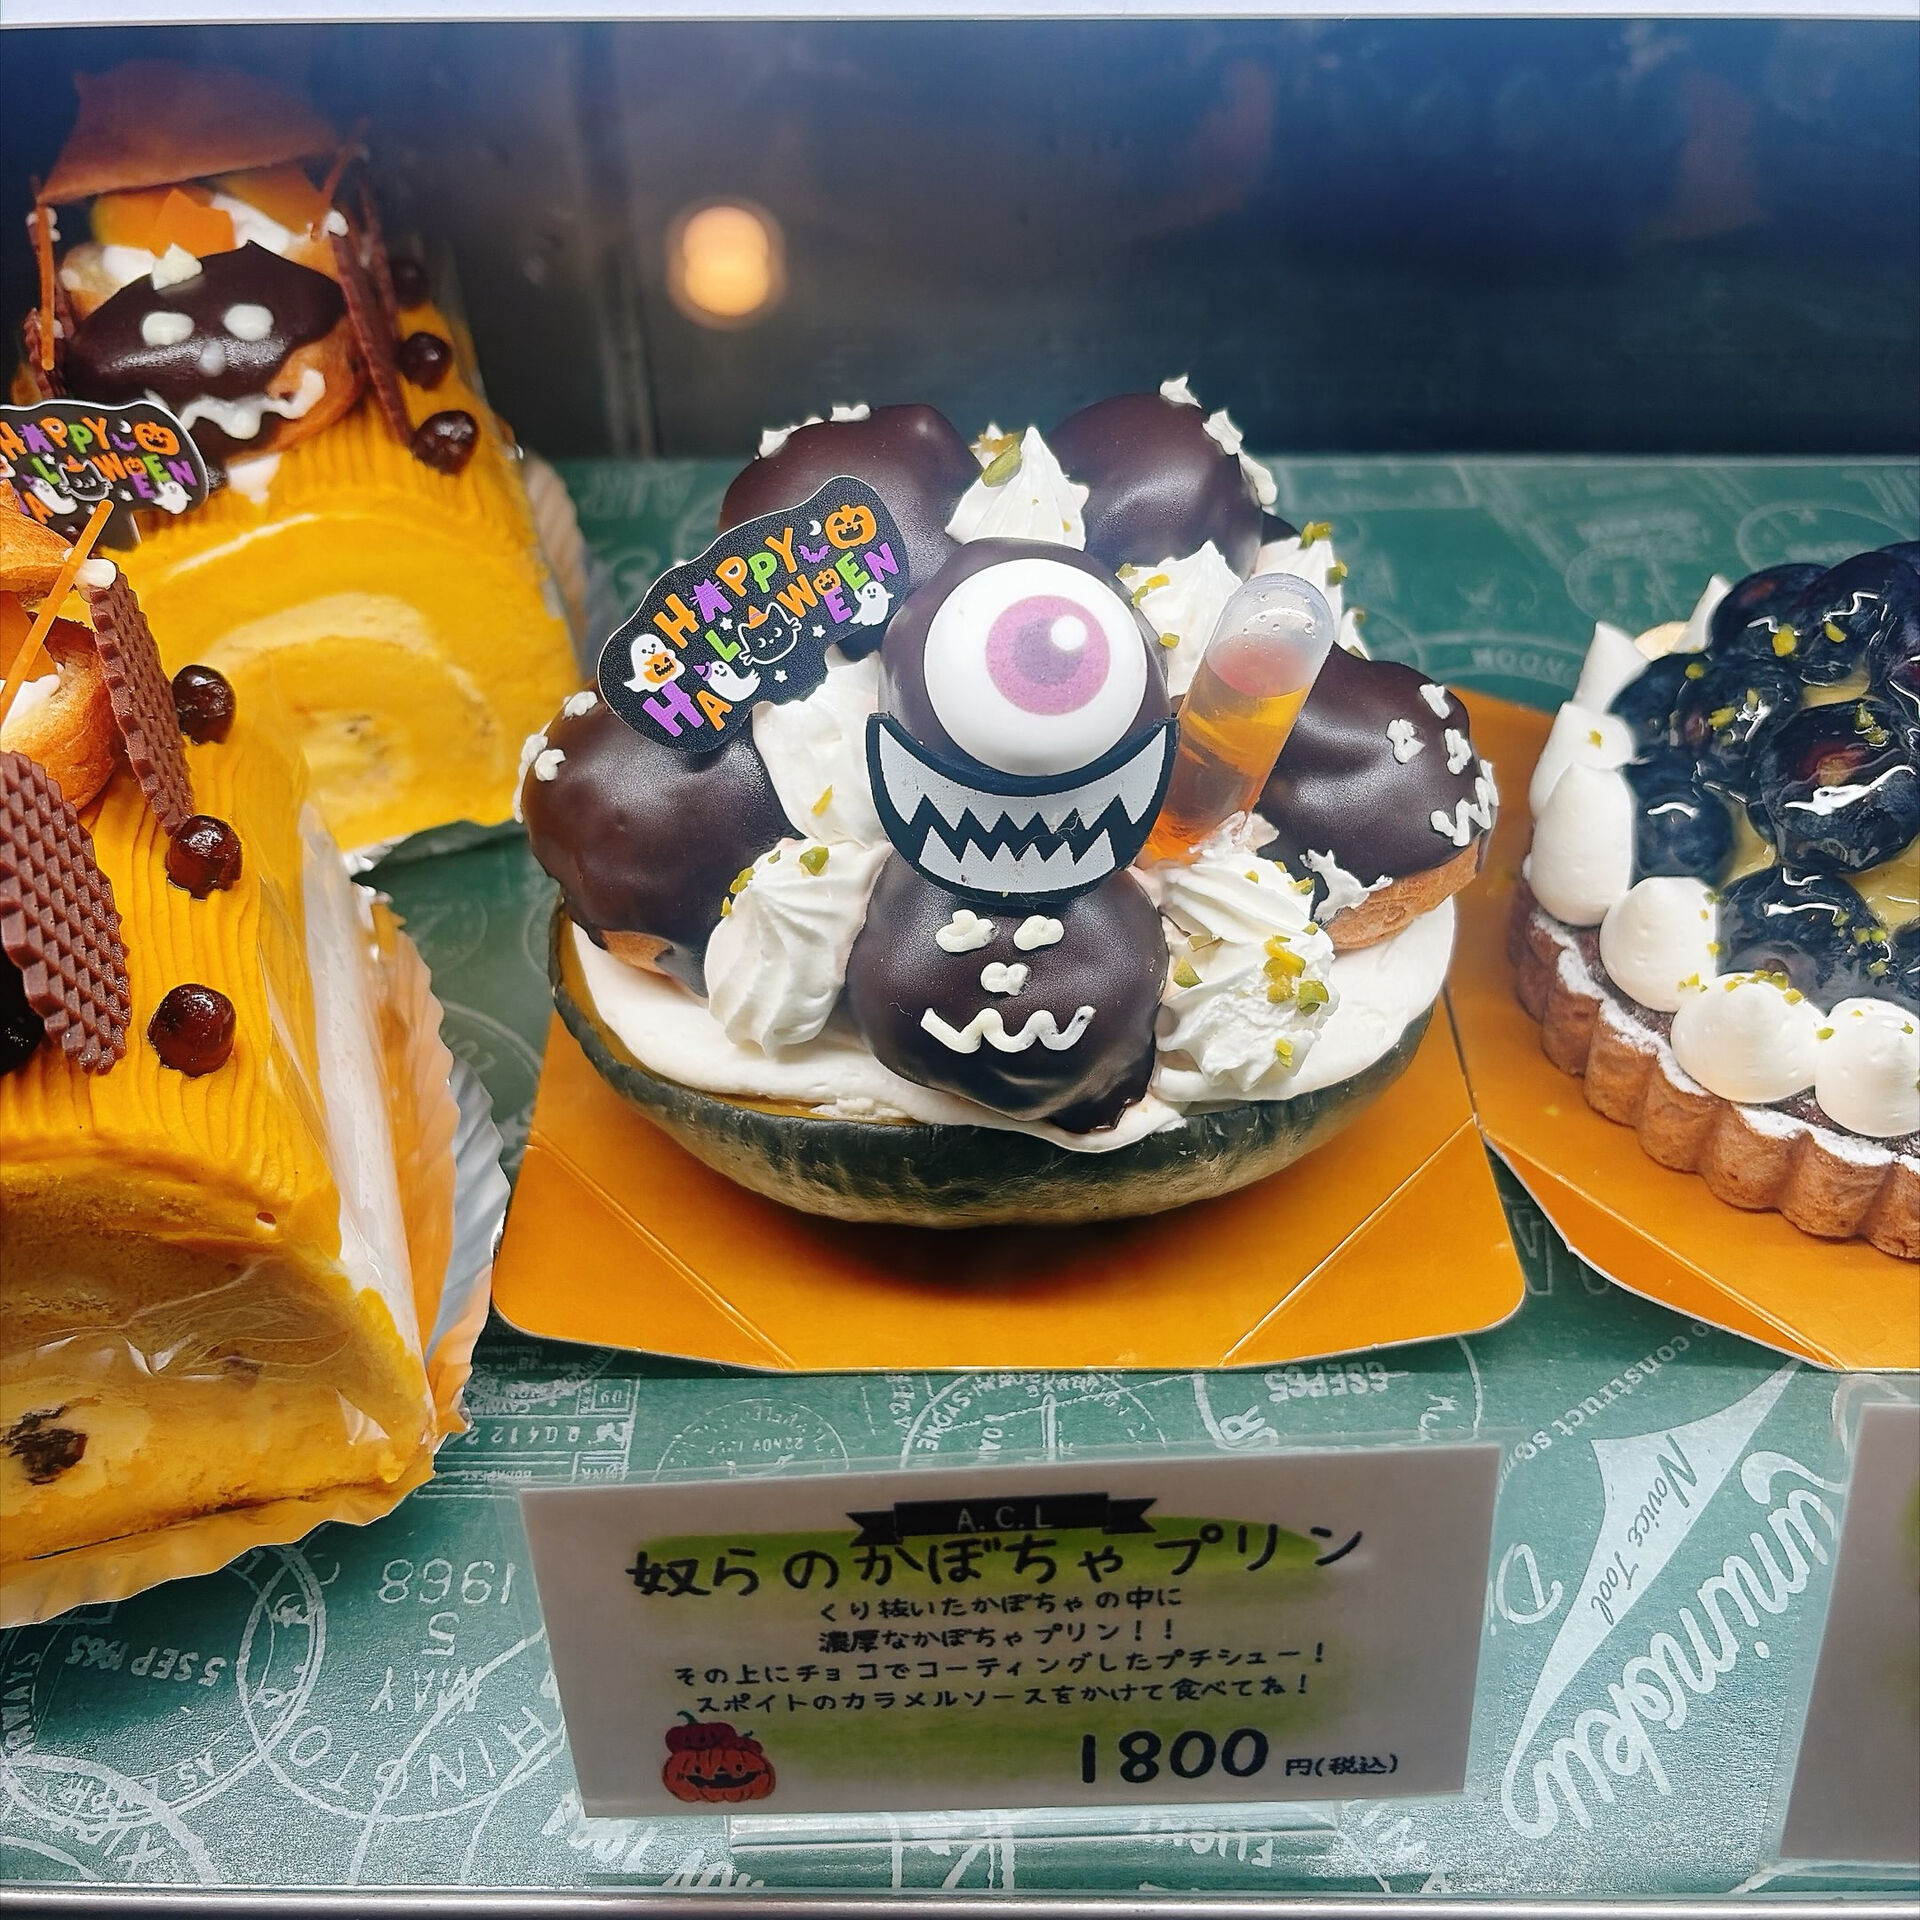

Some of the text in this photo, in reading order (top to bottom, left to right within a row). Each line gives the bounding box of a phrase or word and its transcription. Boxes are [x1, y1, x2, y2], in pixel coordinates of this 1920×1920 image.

[653, 528, 798, 649] HAPPY
[1551, 1334, 1691, 1436] construct
[625, 1523, 1364, 1597] 奴らのかぼちゃプリン
[1592, 1432, 1698, 1627] Novice Tool
[377, 1558, 517, 1605] 1968
[819, 1585, 1183, 1623] くり抜いたかぼちゃの中に
[421, 1610, 461, 1657] 5
[1081, 1728, 1270, 1784] 1800
